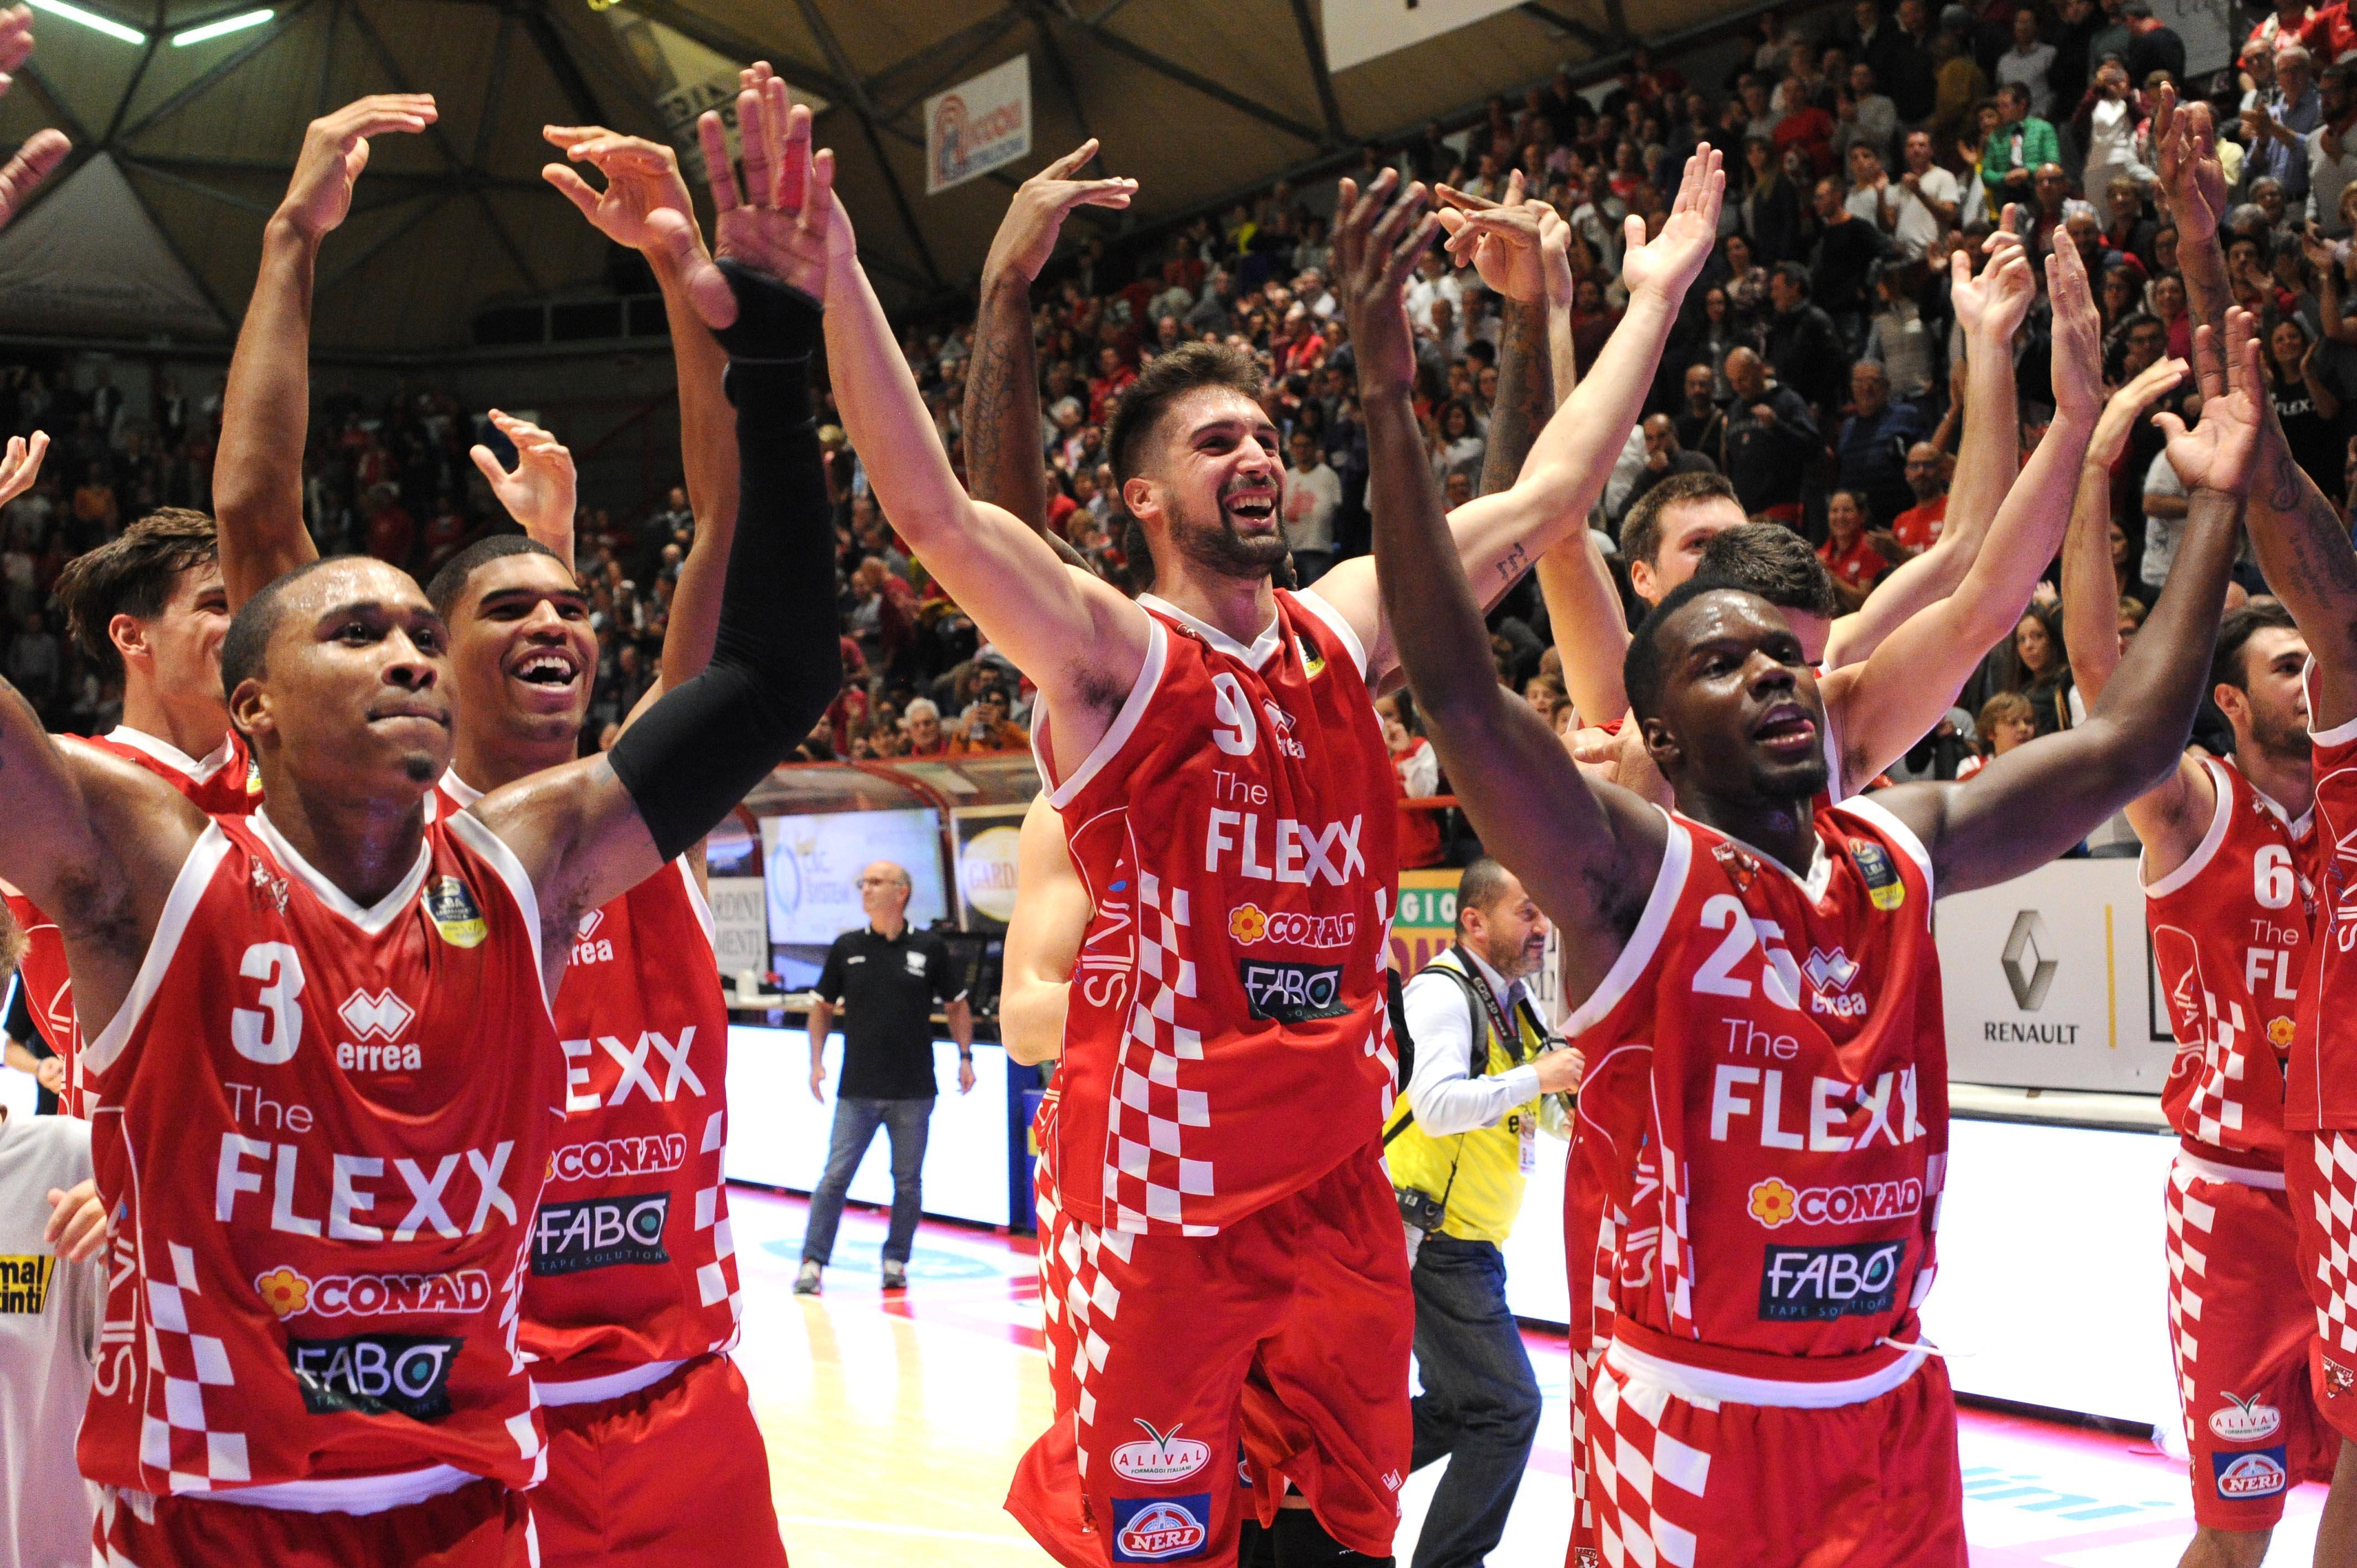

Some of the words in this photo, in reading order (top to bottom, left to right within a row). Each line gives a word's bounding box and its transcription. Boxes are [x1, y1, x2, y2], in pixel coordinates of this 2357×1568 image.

[1211, 672, 1257, 756] 9
[1212, 769, 1268, 805] The
[1206, 807, 1365, 887] FLEXX
[2253, 844, 2294, 910] 6
[1691, 893, 1802, 1011] 25
[2250, 918, 2299, 946] The
[230, 941, 306, 1065] 3
[1721, 1018, 1799, 1060] The
[1984, 1021, 2080, 1045] RENAULT
[224, 1082, 314, 1133] The
[556, 1133, 687, 1182] CONAD
[215, 1132, 518, 1242] FLEXX
[1798, 1177, 1923, 1225] CONAD
[536, 1198, 667, 1255] FABO
[539, 1257, 576, 1271] TAPE
[1767, 1245, 1898, 1299] FABO
[312, 1268, 492, 1318] CONAD
[1769, 1304, 1808, 1317] TAPE
[294, 1342, 451, 1399] FABO
[2215, 1412, 2277, 1428] ALIVAL
[1119, 1450, 1202, 1466] ALIVAL
[1167, 1465, 1192, 1474] ITALIANI
[2229, 1473, 2279, 1492] NERI
[1131, 1529, 1195, 1551] NERI
